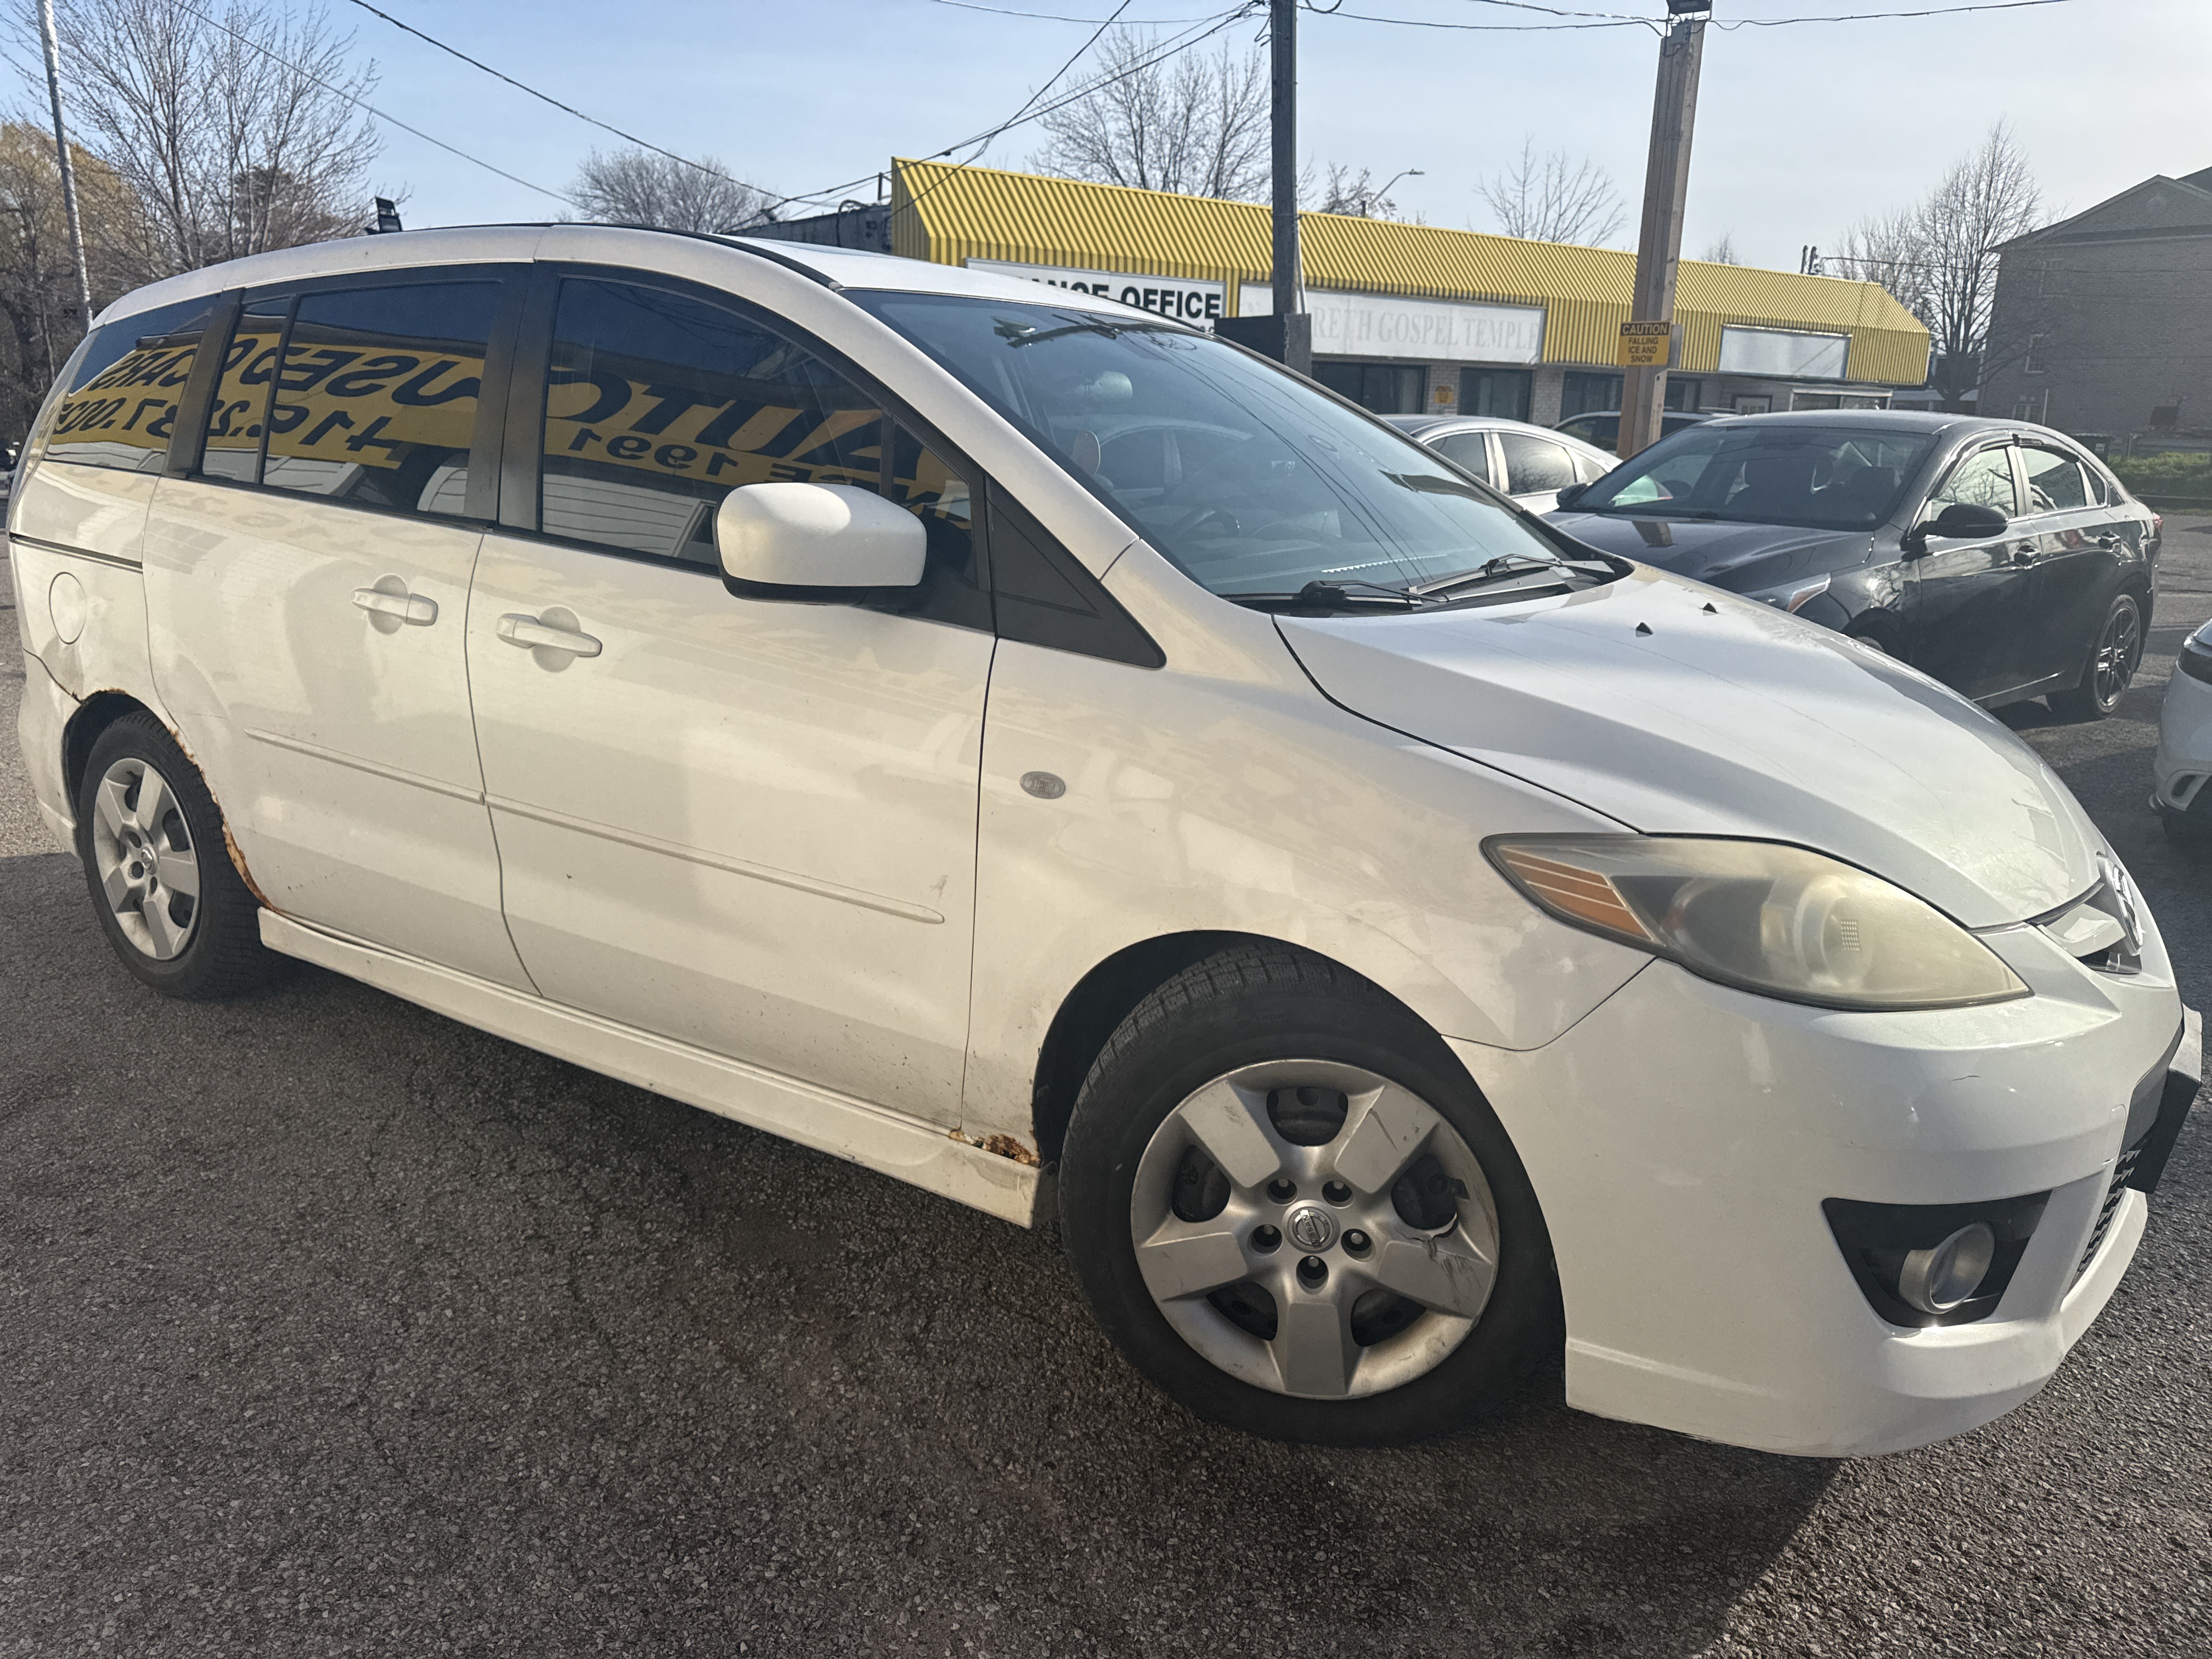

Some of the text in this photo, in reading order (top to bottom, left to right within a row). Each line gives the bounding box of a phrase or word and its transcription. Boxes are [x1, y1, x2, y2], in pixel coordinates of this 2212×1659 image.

[1120, 286, 1221, 319] OFFICE
[1378, 311, 1459, 346] GOSPEL
[1463, 318, 1538, 350] TEMPLE
[1622, 324, 1668, 335] CAUTION
[1641, 346, 1657, 354] AND
[1302, 1214, 1319, 1248] NISSAN
